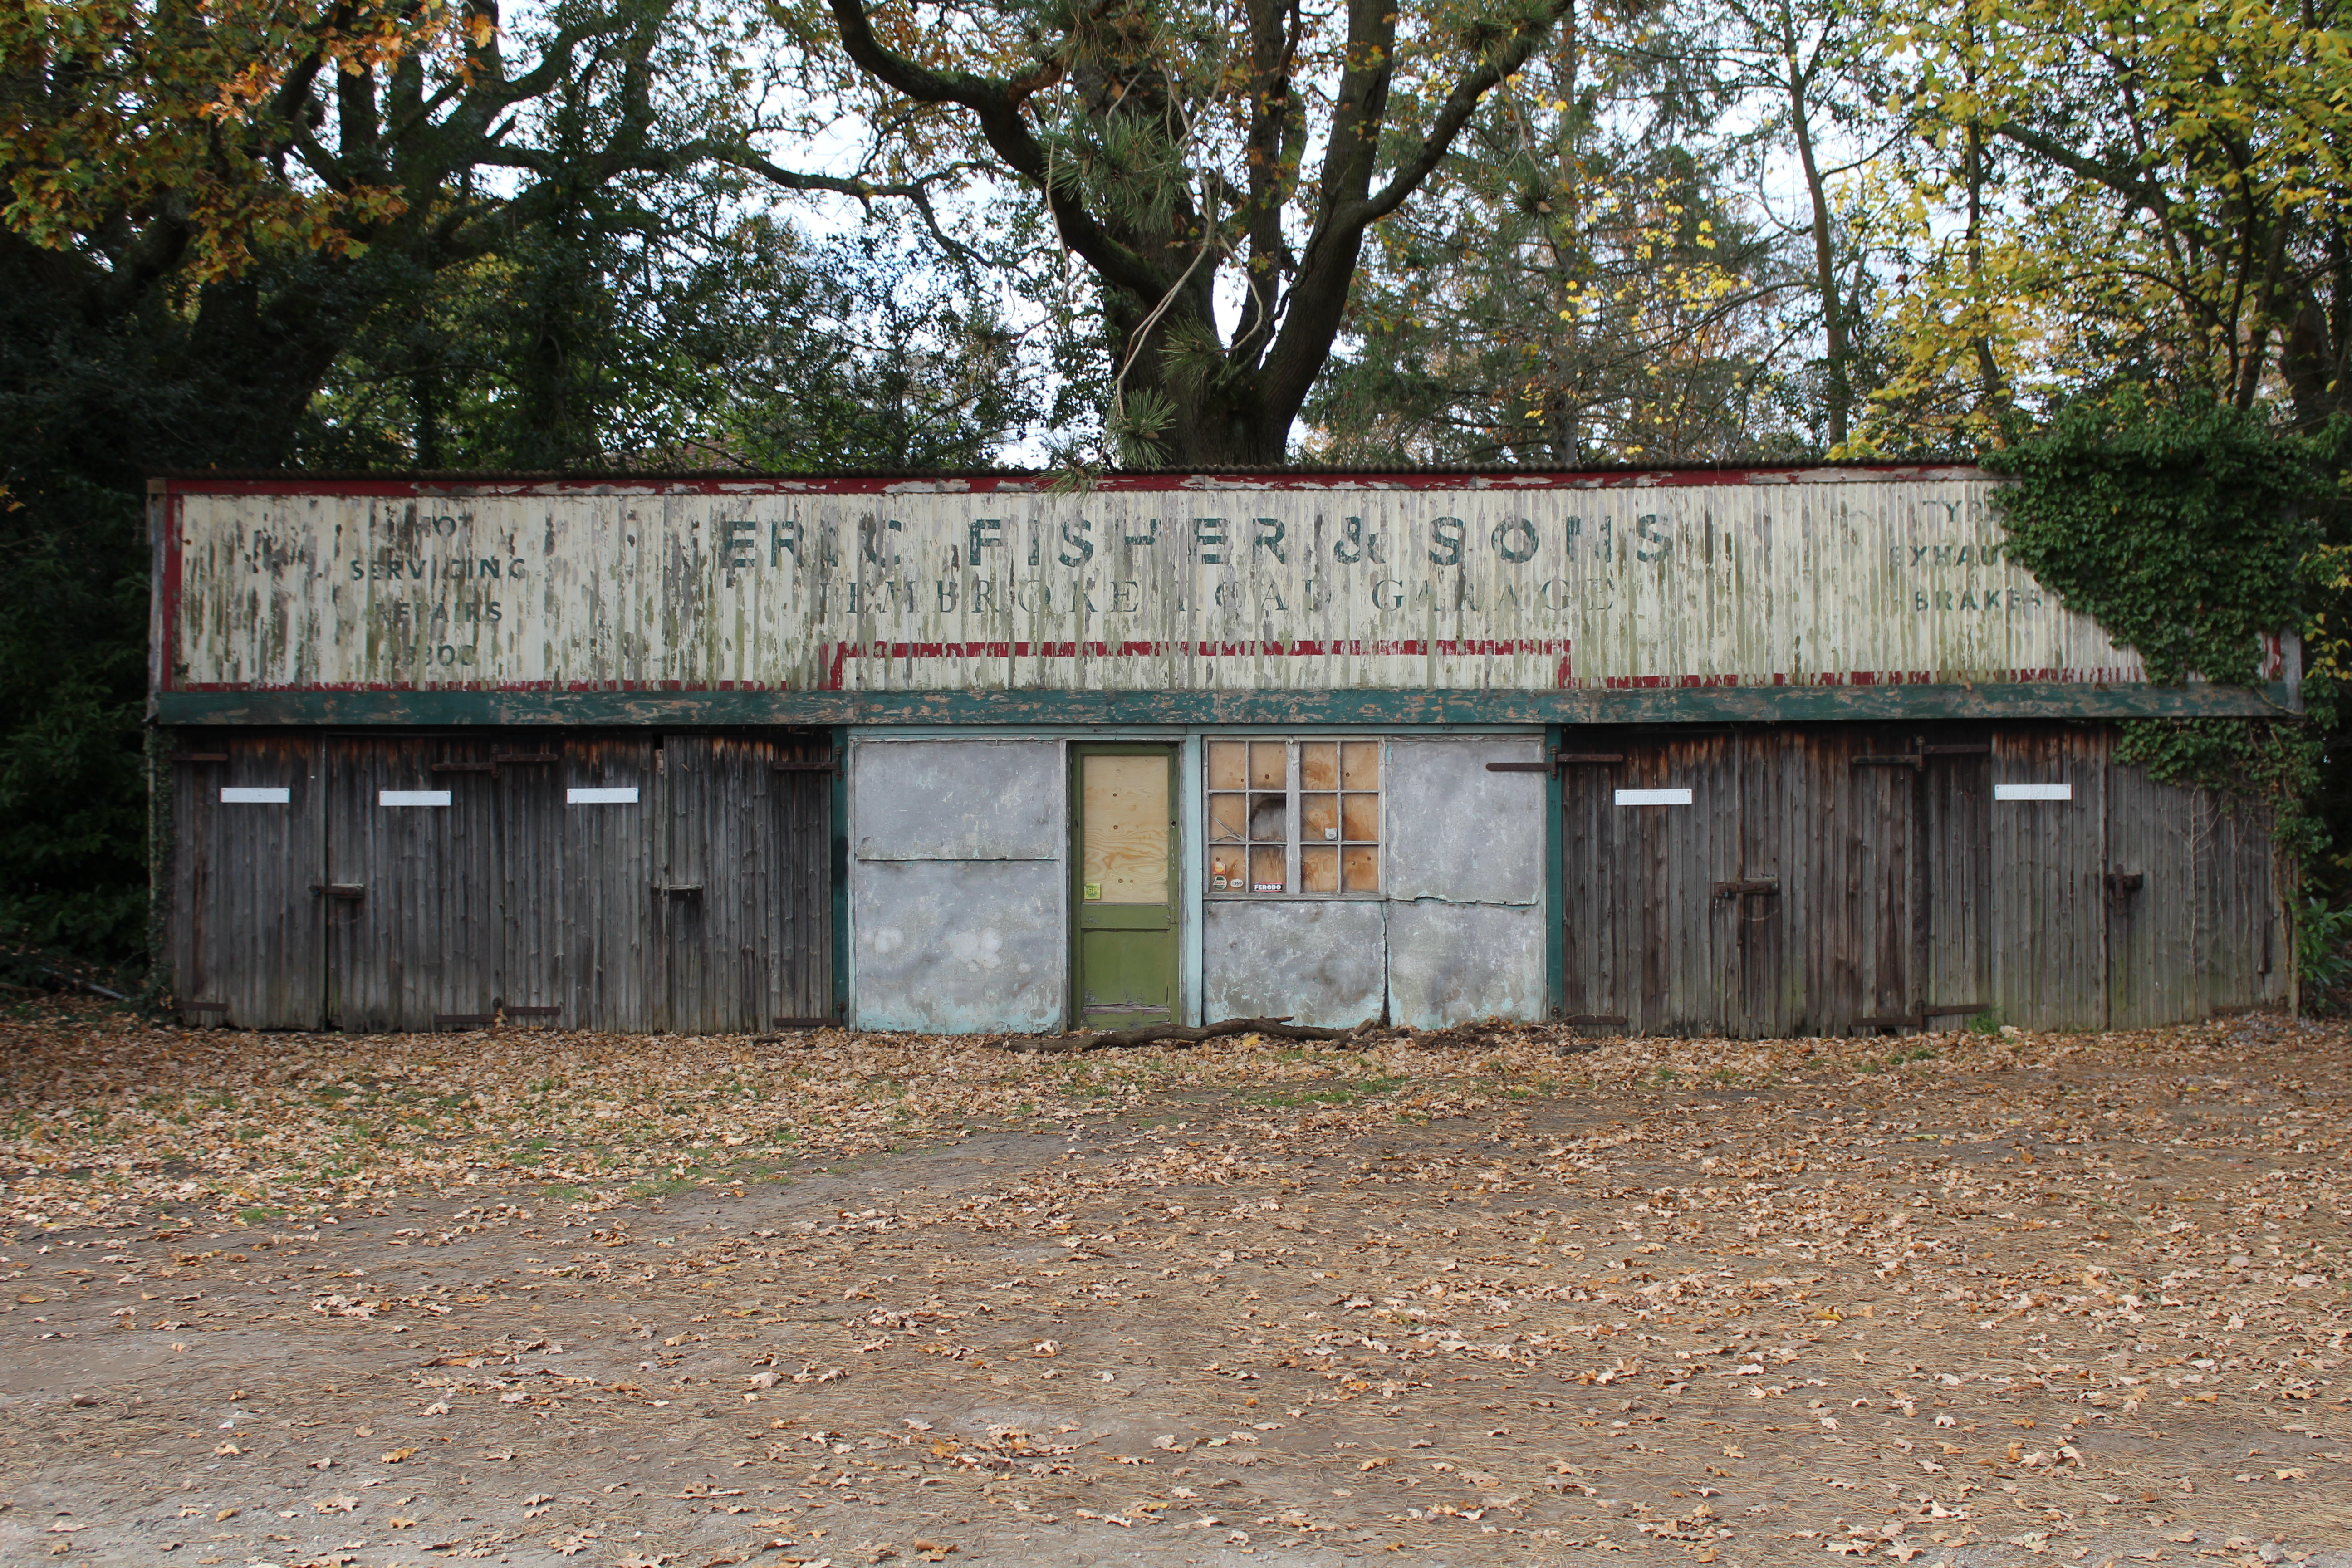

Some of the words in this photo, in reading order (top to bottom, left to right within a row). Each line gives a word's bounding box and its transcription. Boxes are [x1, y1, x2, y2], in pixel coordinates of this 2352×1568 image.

[1334, 516, 1385, 564] &
[1428, 513, 1672, 566] SONS
[350, 559, 525, 580] SERVICING
